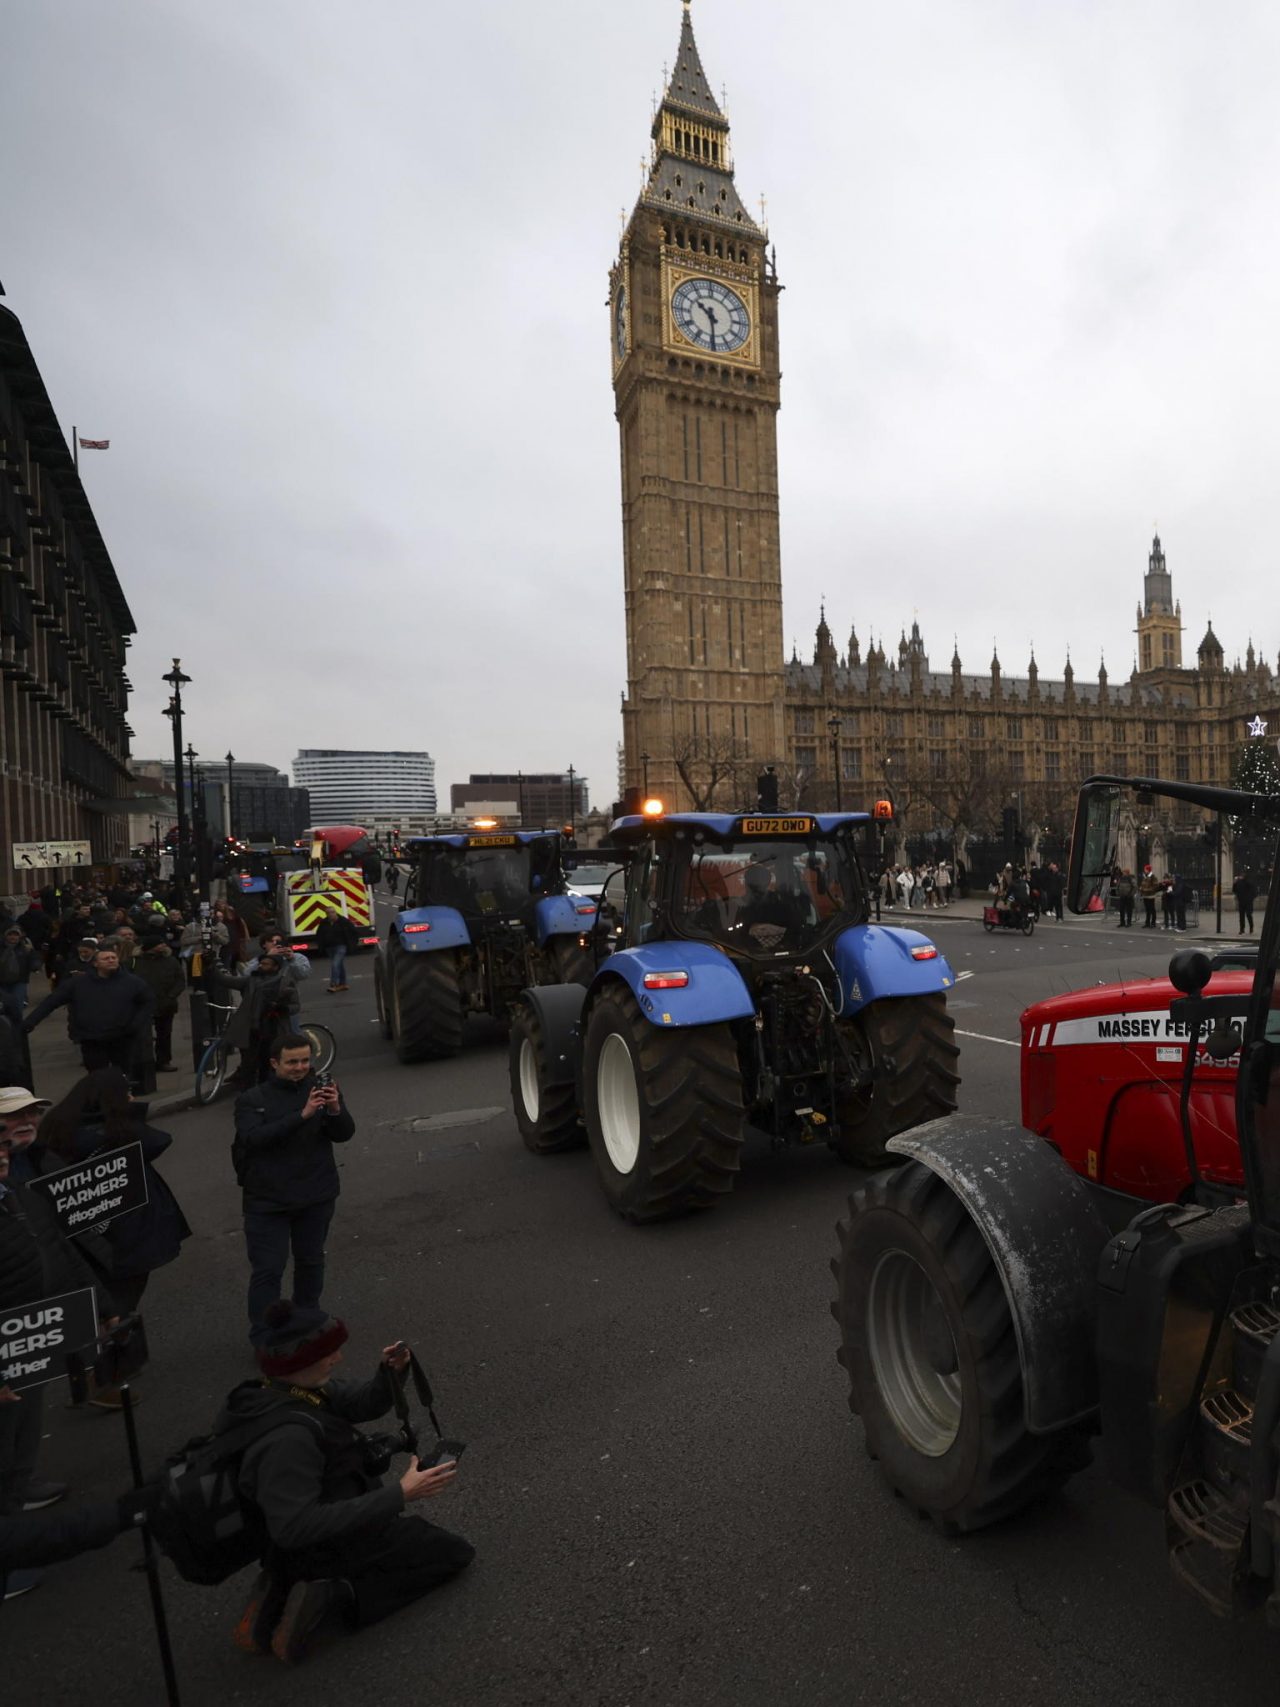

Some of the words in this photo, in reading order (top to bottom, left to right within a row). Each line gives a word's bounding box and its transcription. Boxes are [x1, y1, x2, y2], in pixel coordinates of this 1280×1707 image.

[746, 820, 779, 832] GU72
[1098, 1019, 1161, 1038] MASSEY
[48, 1169, 92, 1196] WITH
[94, 1156, 128, 1178] OUR
[56, 1173, 129, 1213] FARMERS
[67, 1195, 123, 1226] #together
[1, 1306, 65, 1336] OUR
